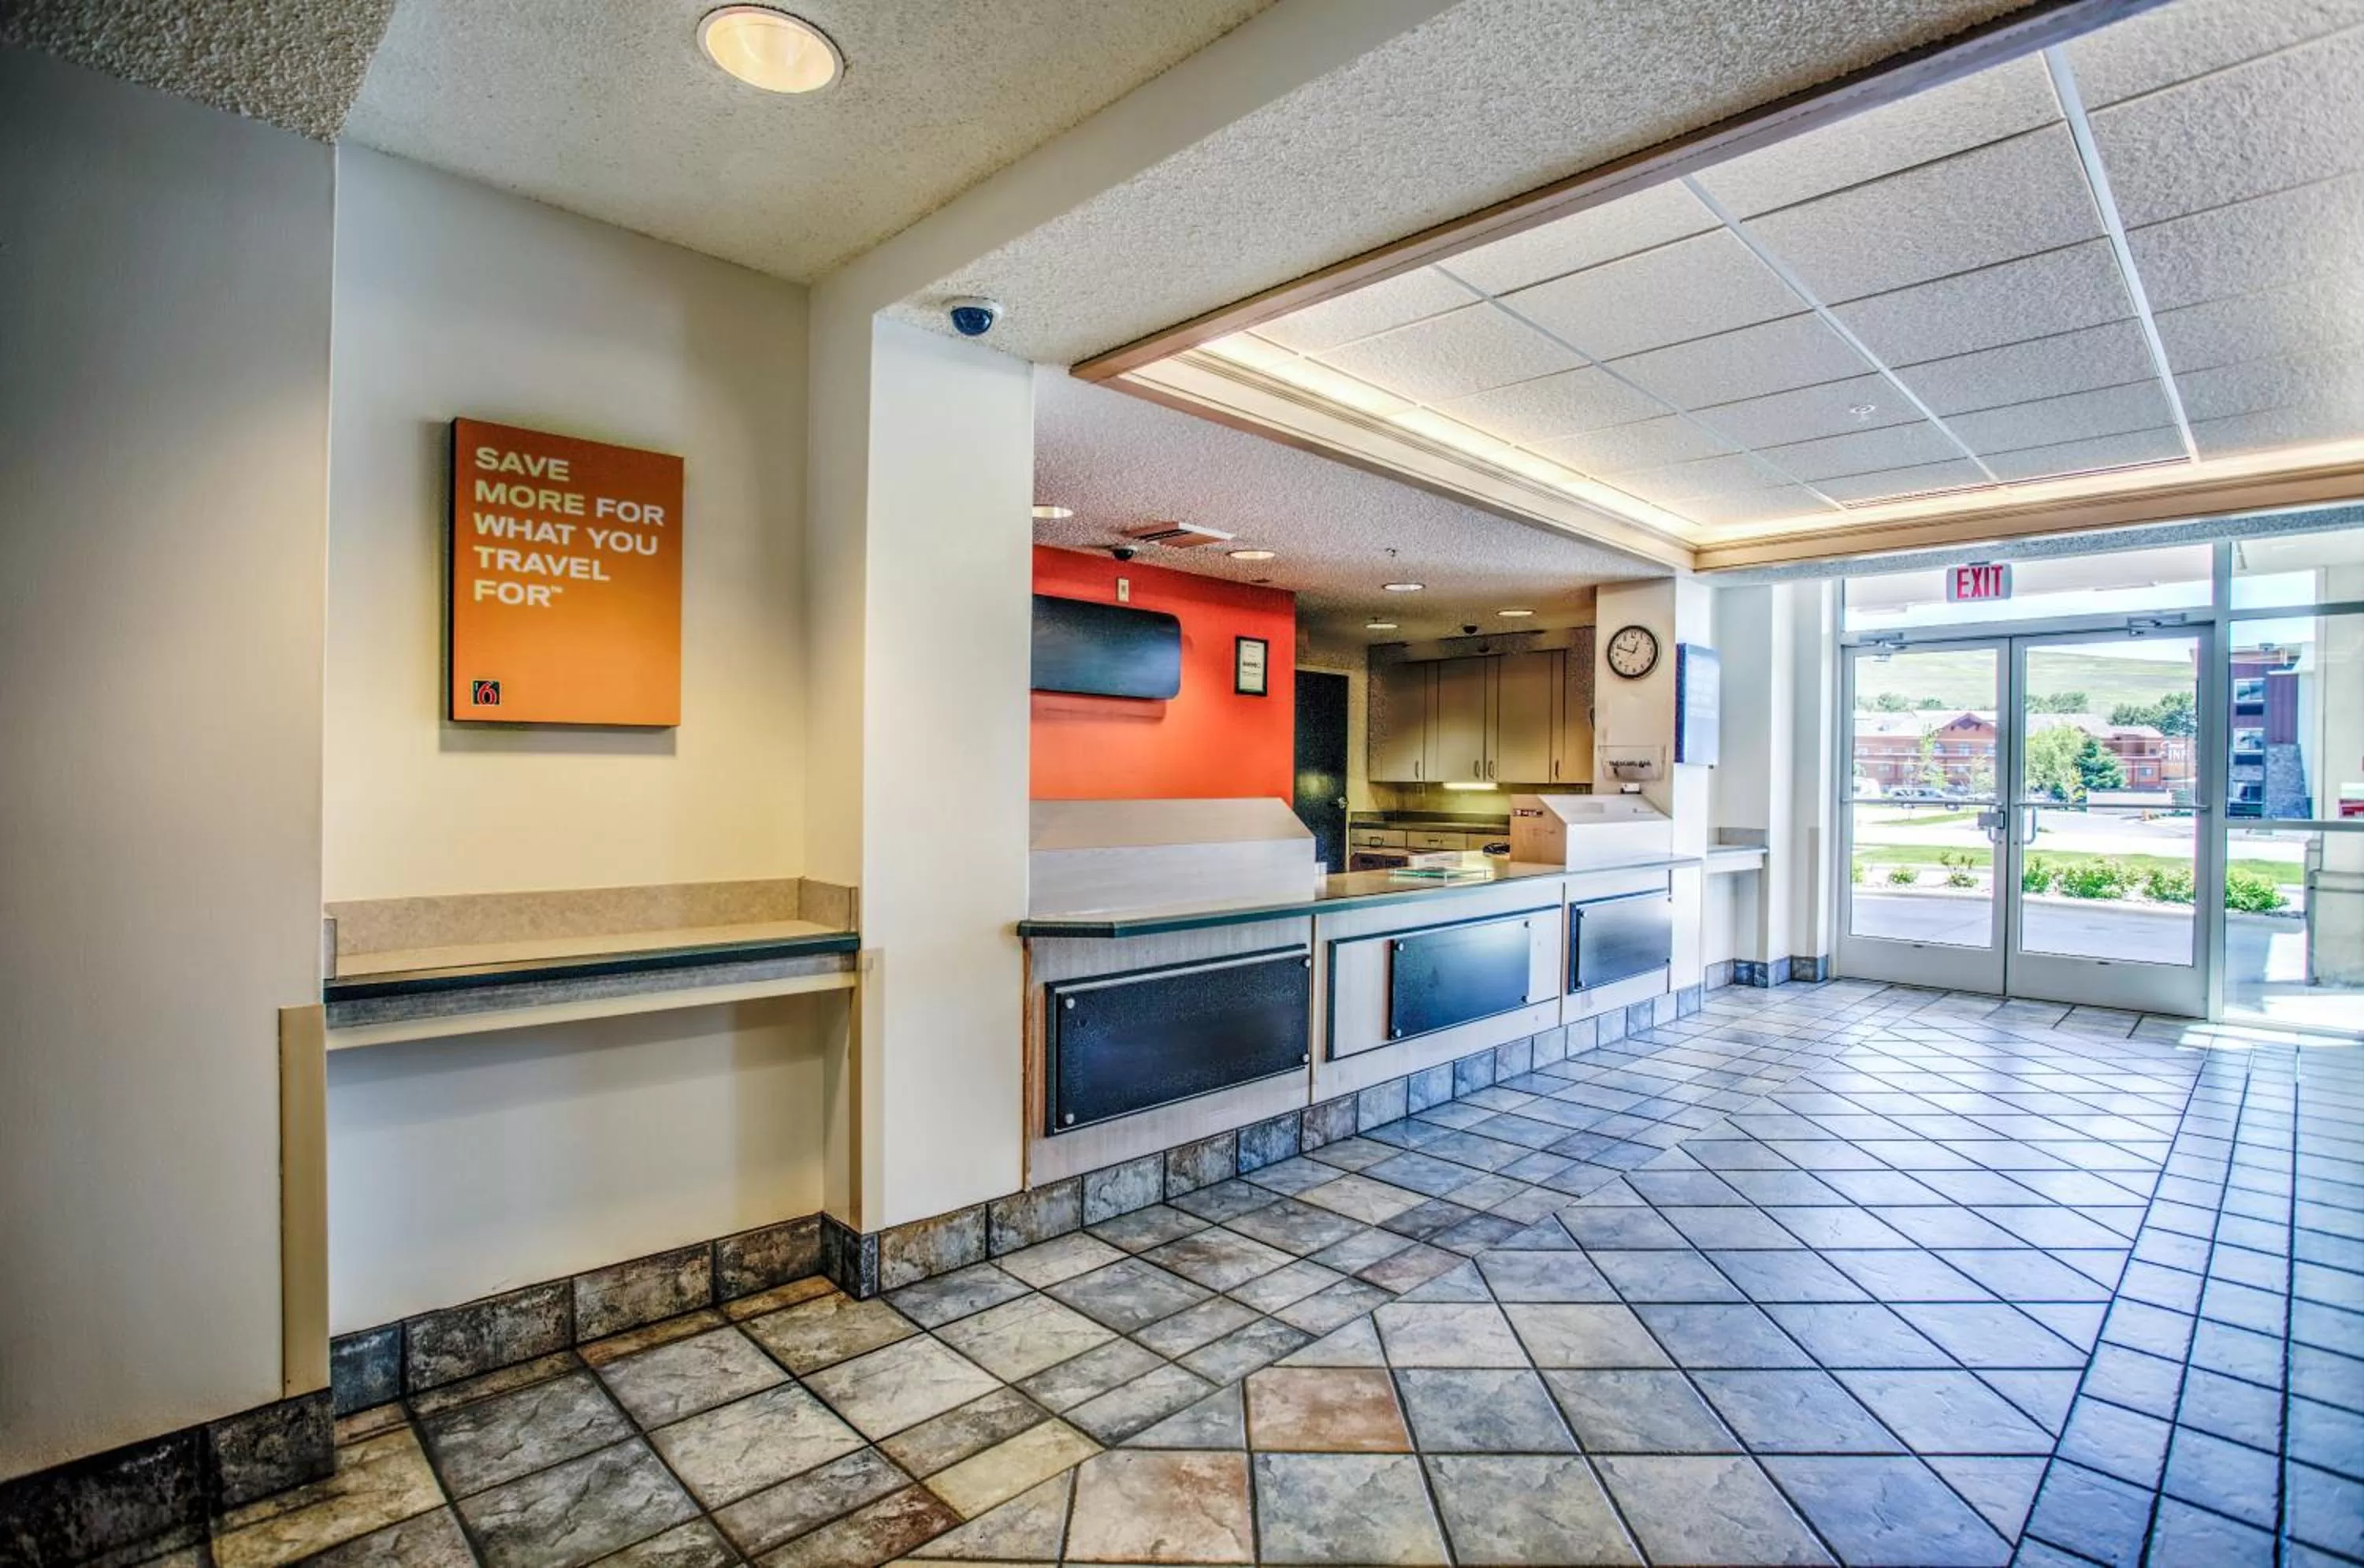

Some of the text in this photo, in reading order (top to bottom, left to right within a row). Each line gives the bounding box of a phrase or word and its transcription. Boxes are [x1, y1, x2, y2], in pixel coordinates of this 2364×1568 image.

[474, 446, 570, 482] SAVE
[474, 479, 665, 527] MORE FOR
[474, 512, 659, 555] WHAT YOU
[473, 544, 611, 581] TRAVEL
[1957, 564, 2003, 599] EXIT
